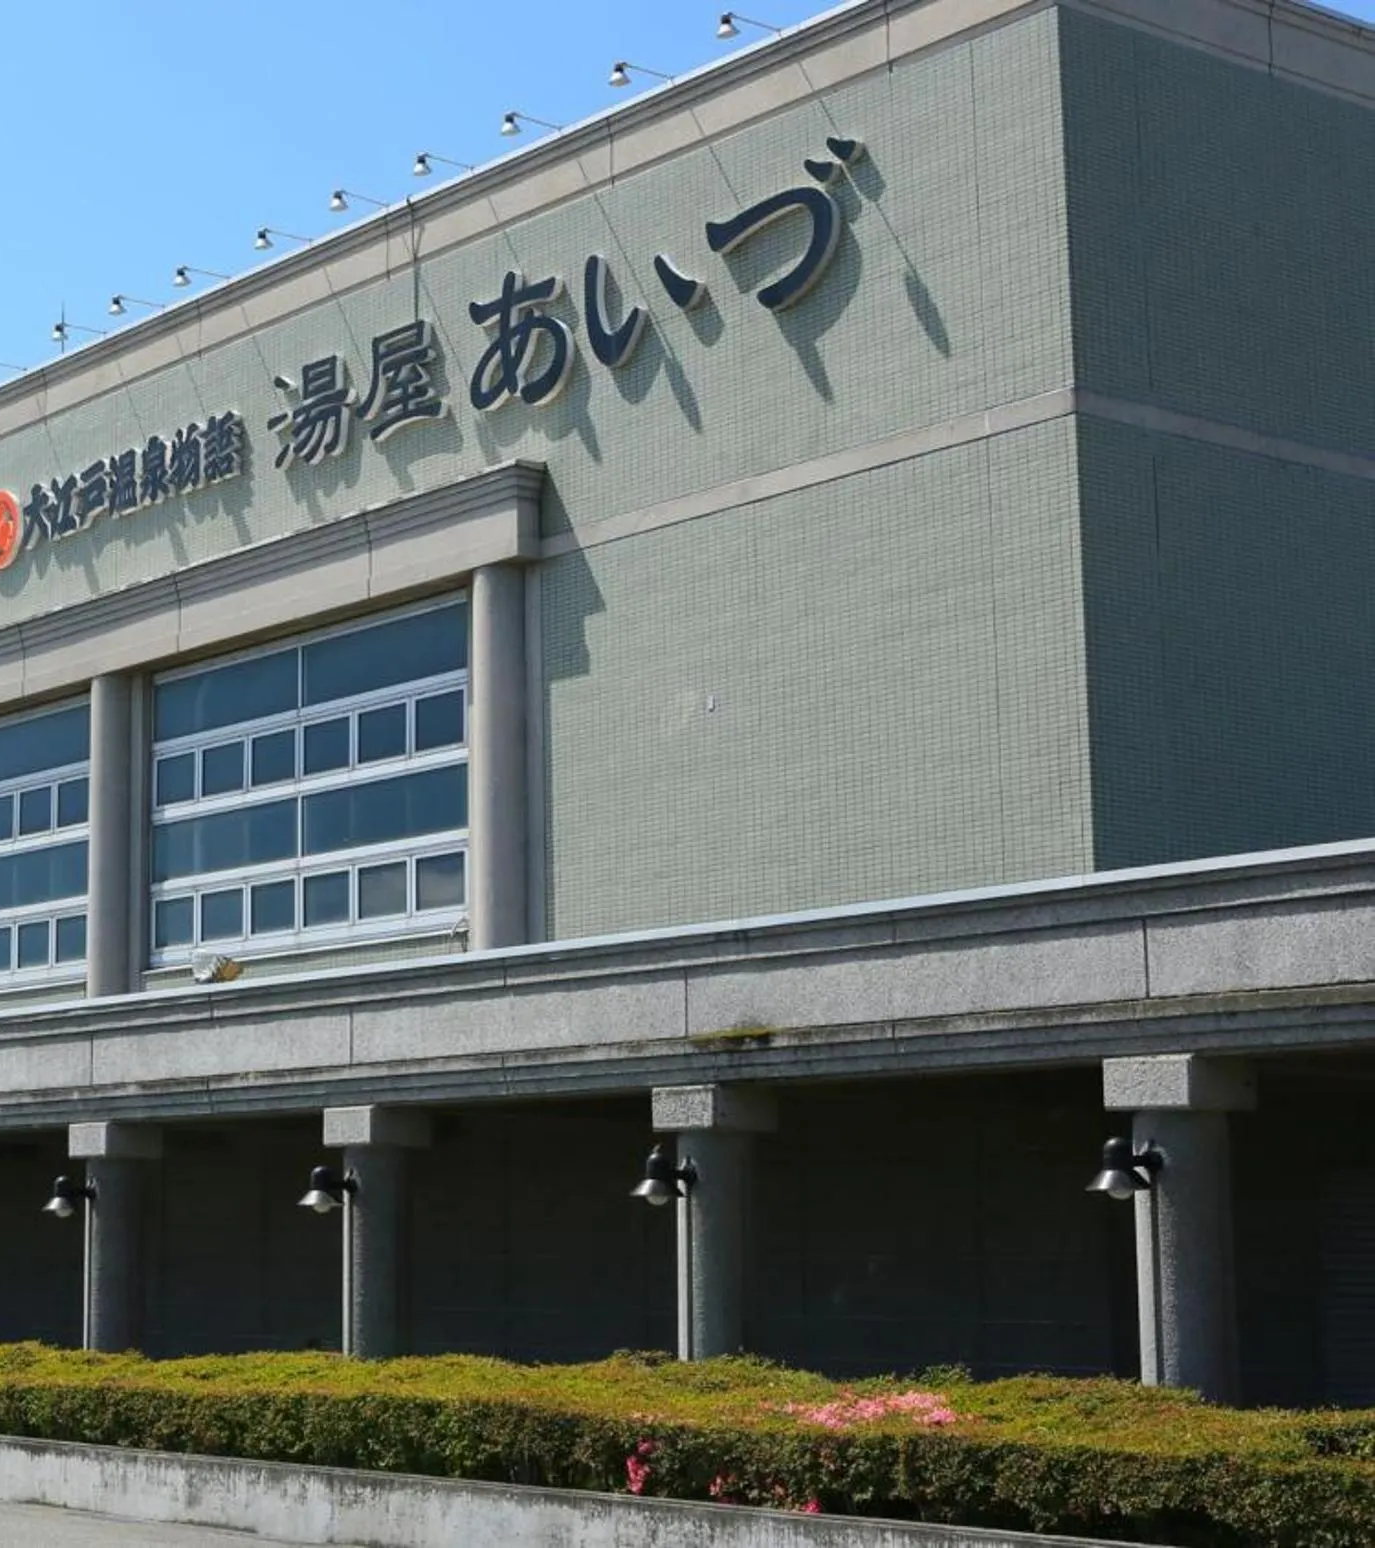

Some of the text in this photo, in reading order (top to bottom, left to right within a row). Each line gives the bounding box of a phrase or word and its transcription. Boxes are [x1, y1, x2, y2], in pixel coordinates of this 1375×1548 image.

[23, 410, 242, 549] 大江戸温泉物語
